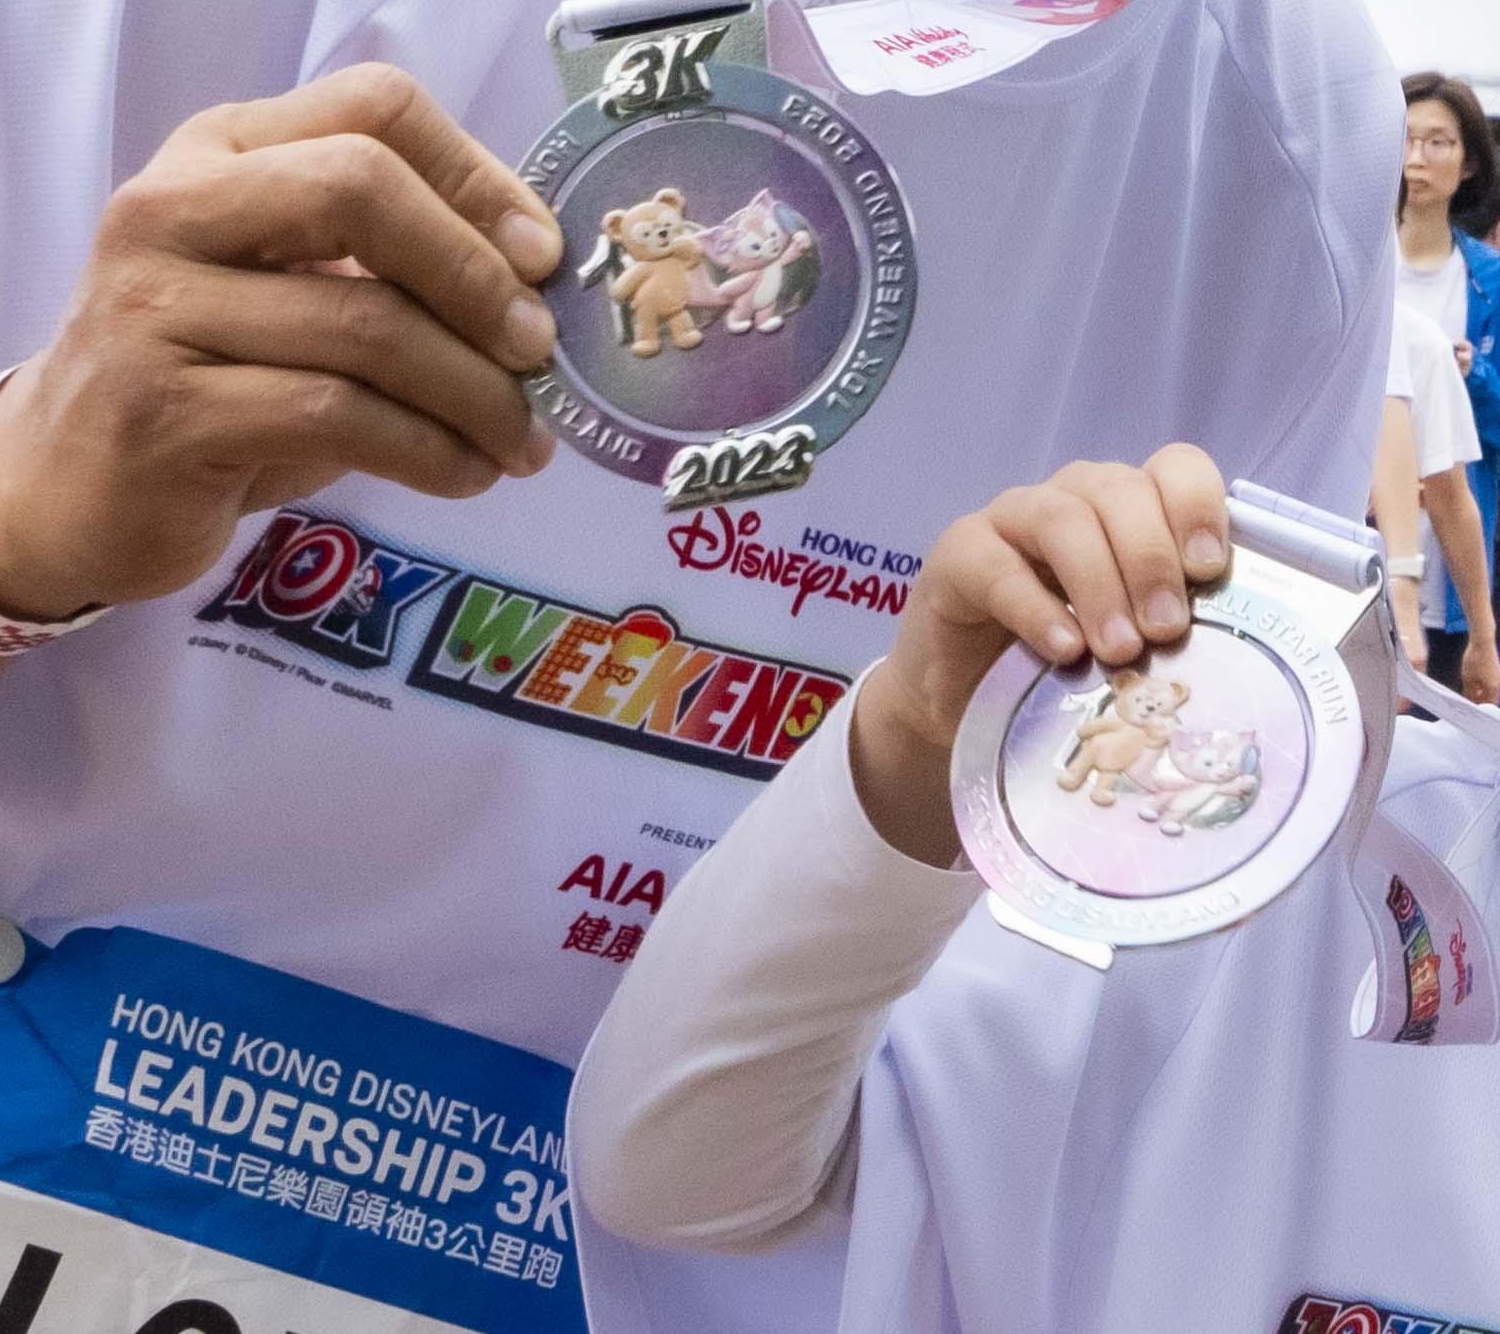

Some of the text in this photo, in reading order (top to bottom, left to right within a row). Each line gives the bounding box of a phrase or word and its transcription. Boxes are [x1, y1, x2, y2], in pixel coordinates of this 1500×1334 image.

[800, 526, 923, 579] HONG KON
[205, 509, 852, 773] 10K WEEKEND
[1256, 609, 1321, 667] STAR
[1308, 668, 1350, 726] RUN
[557, 854, 666, 916] AIA
[639, 822, 717, 851] PRESENT
[561, 910, 646, 964] 健康
[109, 992, 227, 1061] HONG
[230, 1030, 342, 1098] KONG
[94, 1037, 571, 1244] LEADERSHIP 3K
[83, 1103, 564, 1290] 香港迪士尼樂園領袖3公里跑
